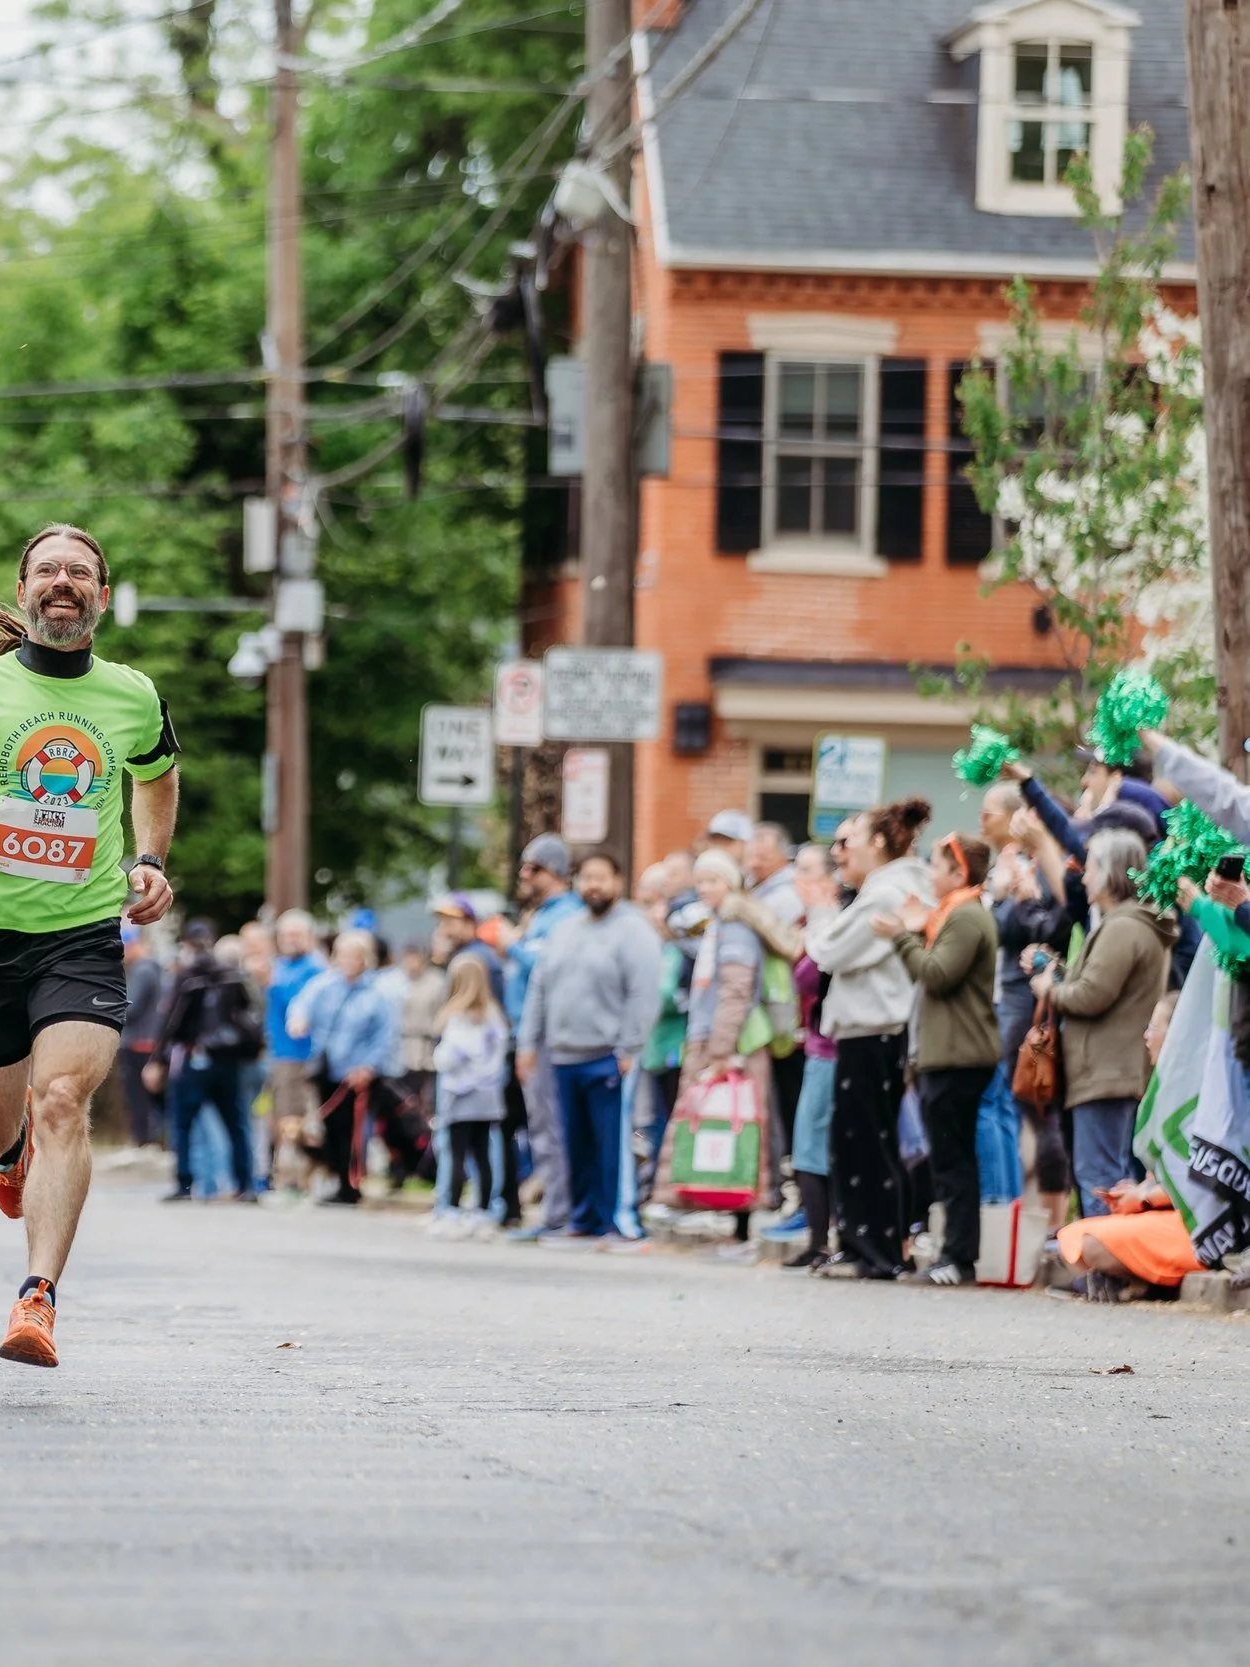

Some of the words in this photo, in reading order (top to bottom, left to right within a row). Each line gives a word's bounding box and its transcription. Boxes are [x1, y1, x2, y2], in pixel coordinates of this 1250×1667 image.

[0, 730, 21, 786] REHOBOTH
[19, 712, 55, 732] BEACH
[59, 711, 104, 740] RUNNING
[102, 741, 117, 793] COMPANY
[49, 747, 75, 758] RBRC
[44, 796, 69, 806] 2023
[2, 832, 86, 864] 6087
